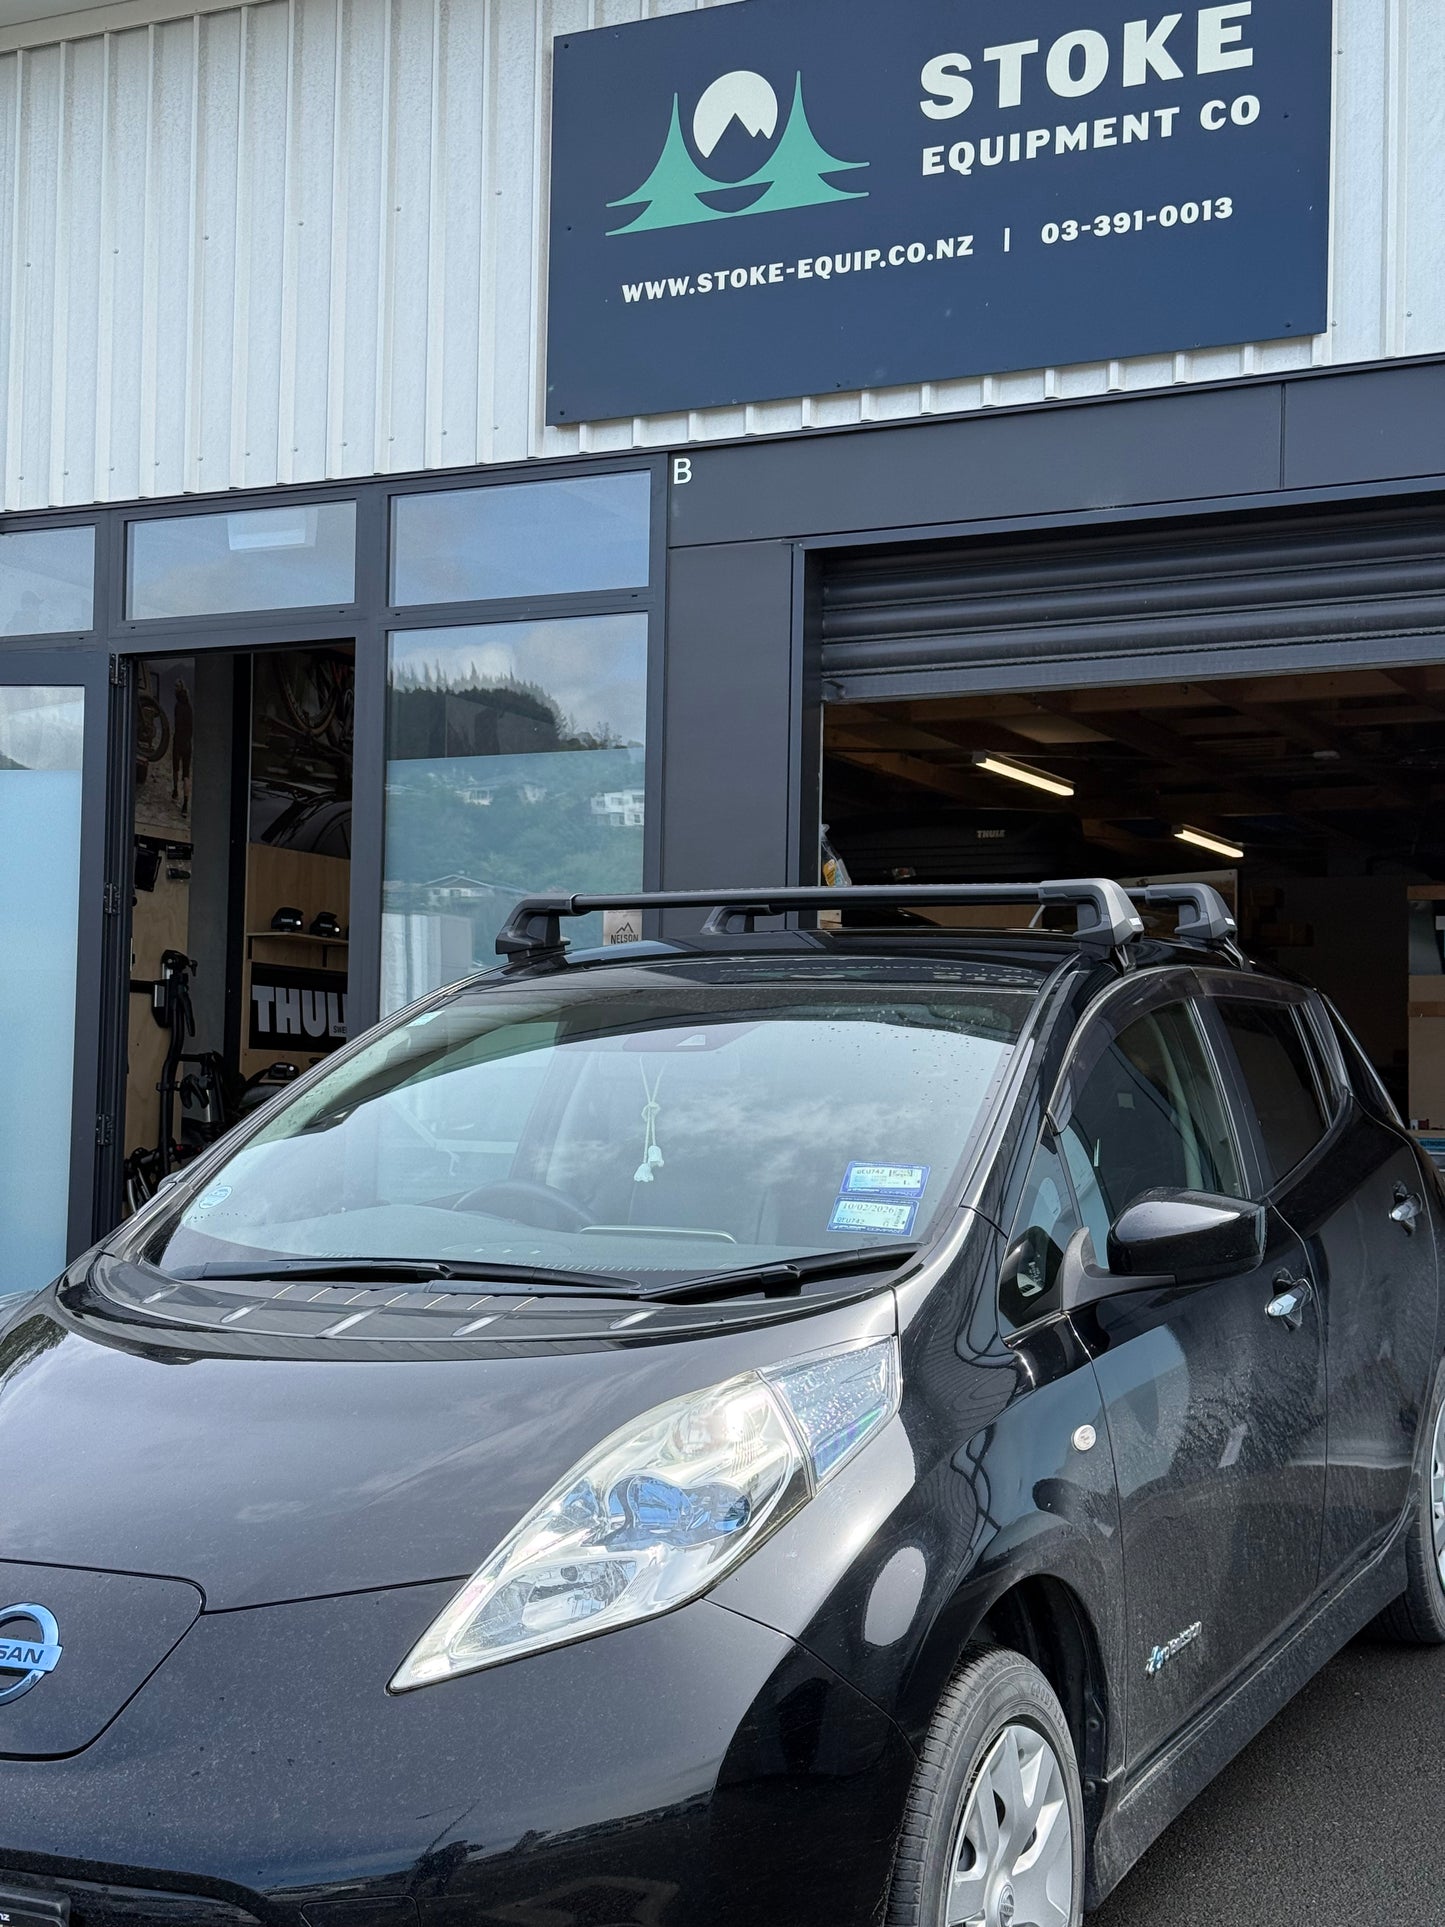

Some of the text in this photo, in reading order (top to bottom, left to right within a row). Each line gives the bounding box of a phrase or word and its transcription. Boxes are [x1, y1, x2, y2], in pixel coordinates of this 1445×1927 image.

[919, 1, 1254, 120] STOKE
[922, 94, 1261, 176] EQUIPMENT CO
[622, 197, 1233, 303] WWW.STOKE-EQUIP.CO.NZ 03-391-0013
[673, 457, 692, 485] B
[610, 934, 639, 944] NELSON
[251, 984, 348, 1038] THUL
[843, 1202, 895, 1213] 10/02/2026
